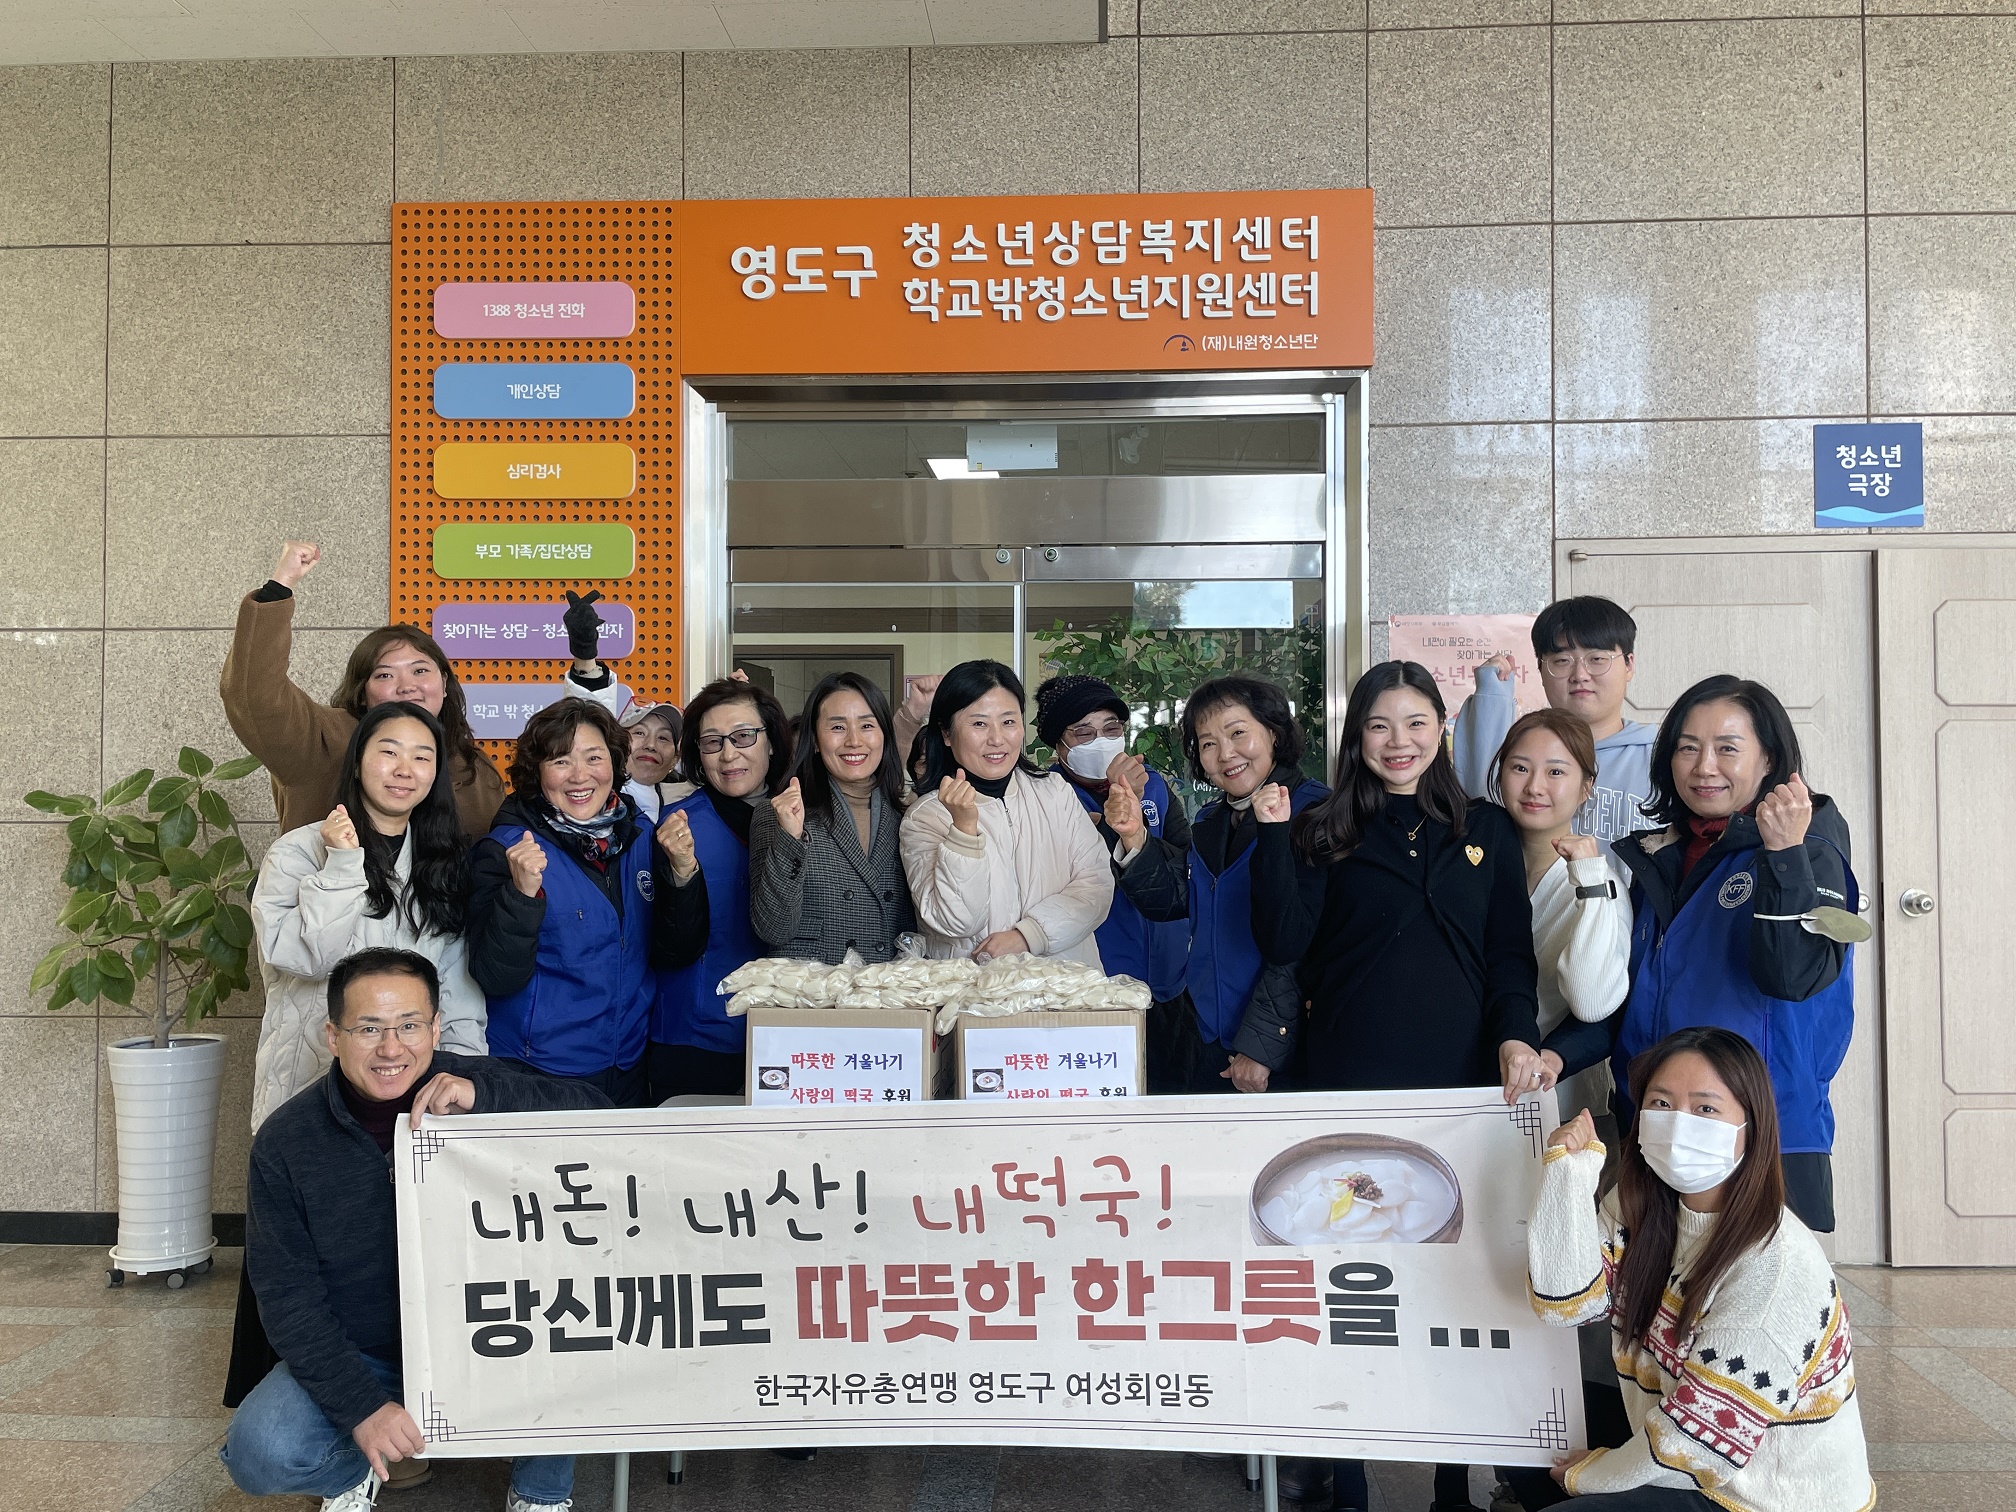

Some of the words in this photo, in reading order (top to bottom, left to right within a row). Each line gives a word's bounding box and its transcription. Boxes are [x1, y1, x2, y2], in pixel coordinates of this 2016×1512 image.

[902, 216, 1320, 267] 청소년상담복지센터
[730, 246, 878, 300] 영도구
[901, 270, 1320, 322] 학교밖청소년지원센터
[482, 304, 512, 317] 1388
[513, 304, 554, 318] 청소년
[558, 303, 586, 318] 전화
[1201, 333, 1319, 352] (재)내원청소년단
[506, 383, 562, 400] 개인상담
[1836, 444, 1902, 469] 청소년
[506, 463, 562, 480] 심리검사
[1848, 472, 1893, 497] 극장
[475, 544, 502, 559] 부모
[507, 543, 593, 560] 가족/집단상담
[443, 623, 497, 639] 찾아가는
[501, 623, 529, 639] 상담
[542, 623, 624, 639] 청소반자
[472, 703, 500, 720] 학교
[503, 703, 518, 720] 밖
[791, 1053, 836, 1070] 따뜻한
[844, 1053, 903, 1071] 겨울나기
[1004, 1053, 1050, 1071] 따뜻한
[1058, 1052, 1118, 1069] 겨울나기
[790, 1087, 834, 1104] 사랑의
[843, 1088, 873, 1103] 떡국
[472, 1162, 641, 1246] 내돈!
[683, 1162, 868, 1242] 내산!
[912, 1155, 1172, 1239] 내떡국!
[464, 1272, 771, 1358] 당신께도
[795, 1259, 1046, 1344] 따뜻한
[1071, 1257, 1400, 1347] 한그릇을
[753, 1371, 957, 1407] 한국자유총연맹
[969, 1371, 1056, 1405] 영도구
[1066, 1371, 1214, 1408] 여성회일동
